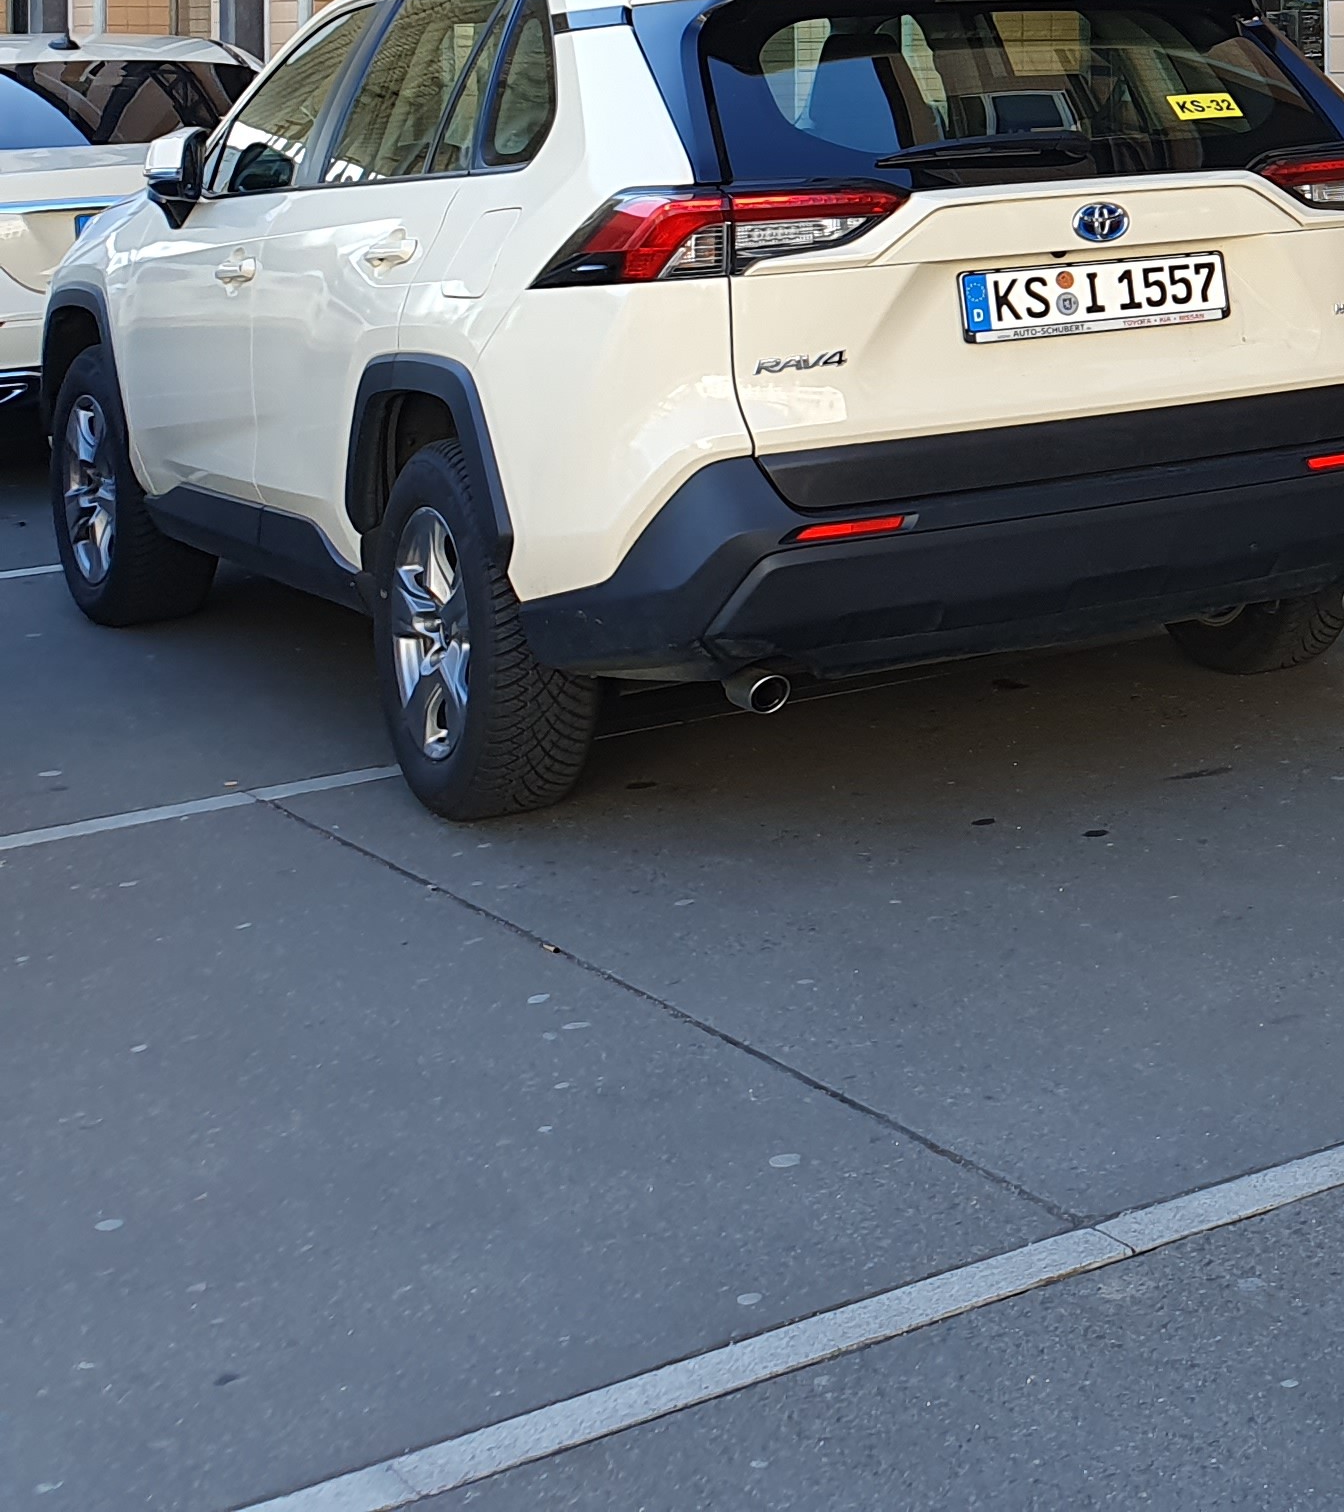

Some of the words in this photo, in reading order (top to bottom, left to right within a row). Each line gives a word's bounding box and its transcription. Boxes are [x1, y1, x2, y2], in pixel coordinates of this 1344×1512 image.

[1176, 99, 1236, 114] KS-32
[993, 276, 1050, 322] KS
[1086, 272, 1105, 314] I
[1117, 262, 1216, 310] 1557
[973, 308, 984, 322] D
[1013, 324, 1085, 337] AUTO-SCHUBERT
[753, 349, 848, 376] RAV4
